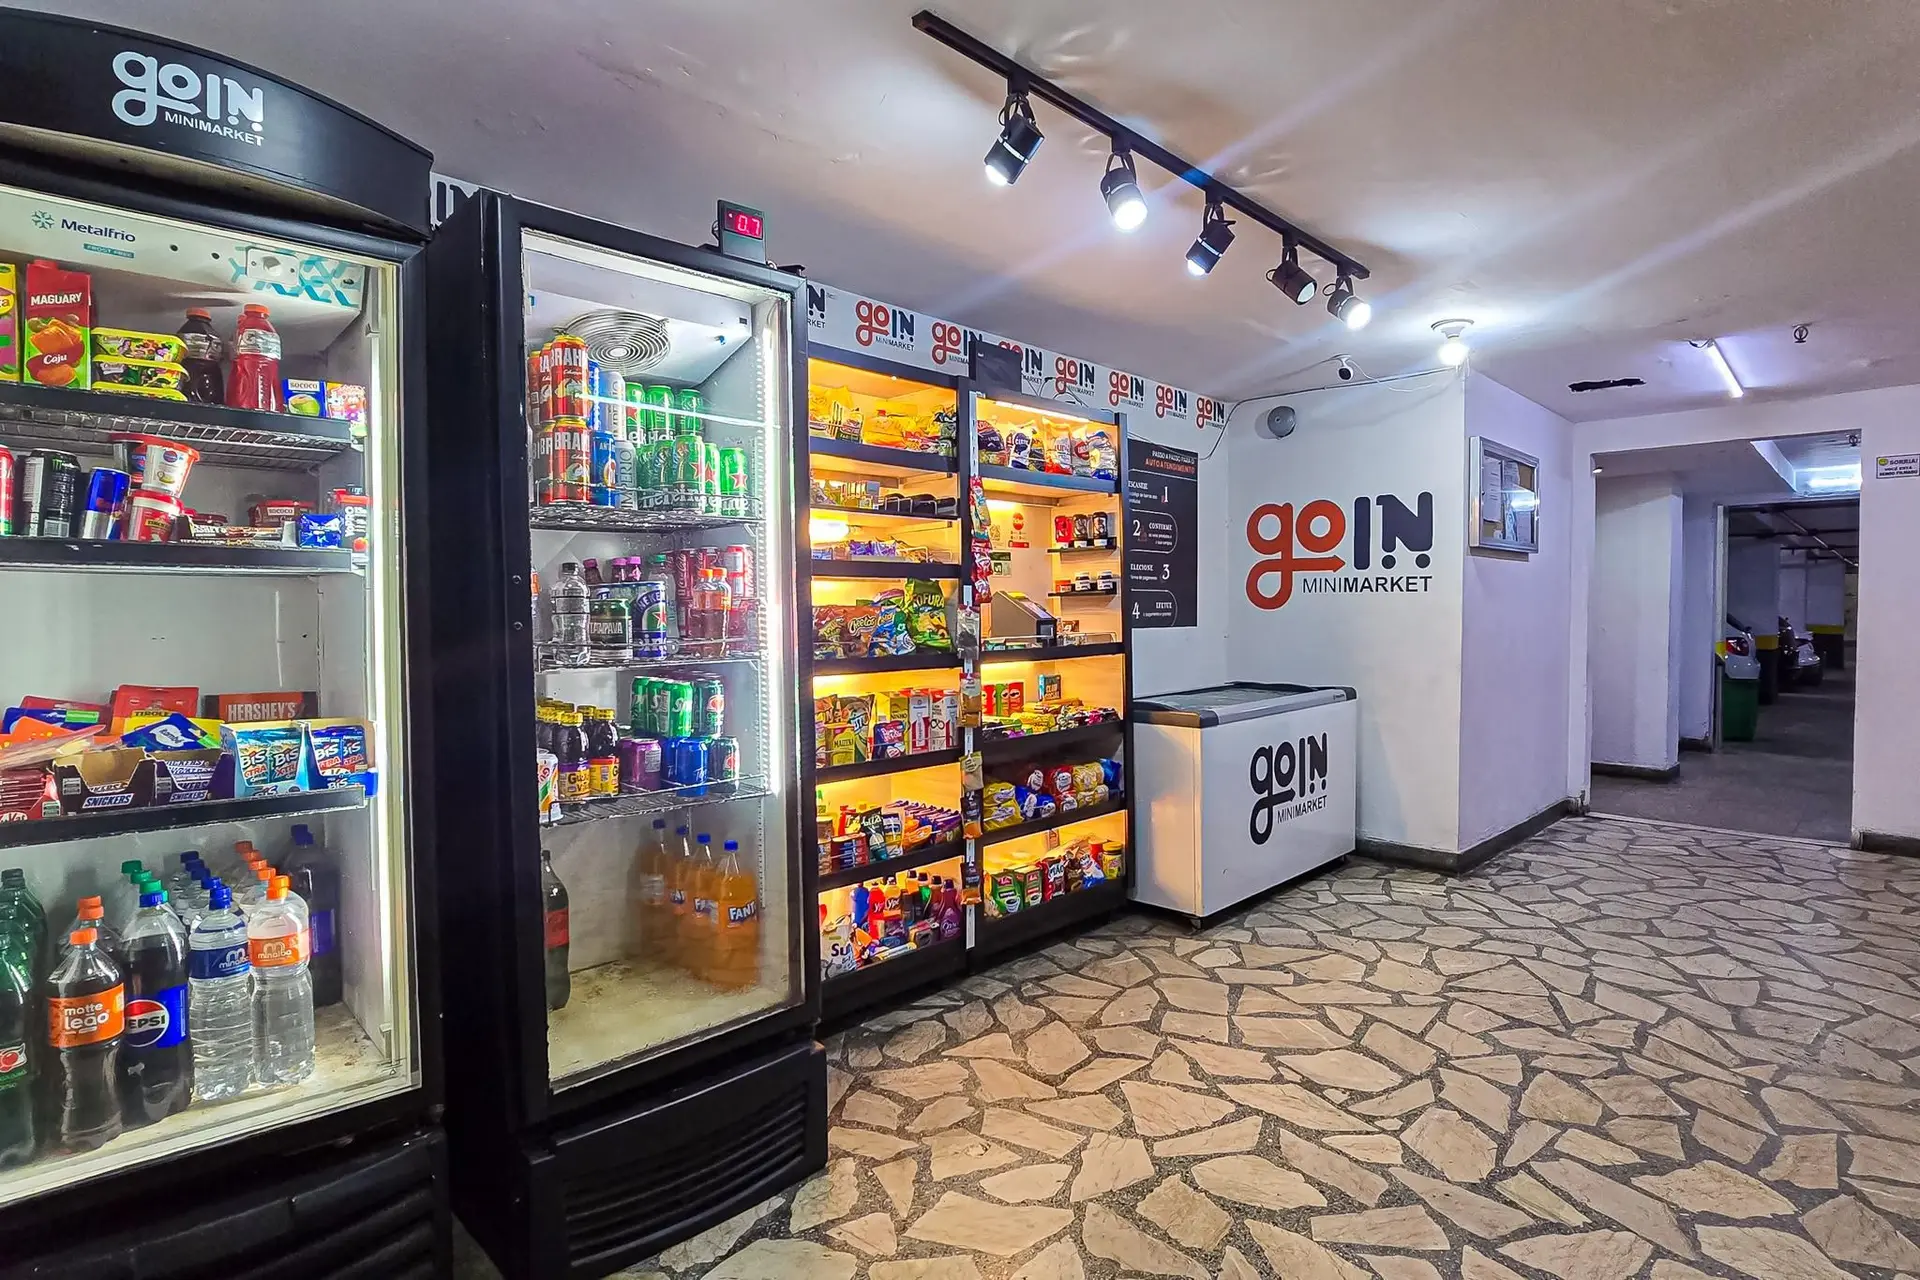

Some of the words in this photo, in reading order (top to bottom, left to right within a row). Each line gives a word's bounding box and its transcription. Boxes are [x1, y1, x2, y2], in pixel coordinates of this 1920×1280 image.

[164, 111, 265, 147] MINIMARKET
[61, 218, 136, 242] Metalfrio
[31, 292, 82, 306] MAGUARY
[290, 382, 318, 390] SOCOCO
[1164, 486, 1169, 503] 1
[1132, 519, 1141, 537] 2
[1162, 563, 1170, 580] 3
[1302, 575, 1433, 594] MINIMARKET
[1132, 601, 1140, 620] 4
[848, 615, 877, 634] Cheetos
[227, 701, 297, 720] HERSHEY'S
[275, 748, 299, 766] BiS
[85, 794, 132, 807] SNICKERS
[170, 791, 206, 801] SNICKERS
[1277, 794, 1327, 824] MINIMARKET
[729, 901, 757, 921] FANT
[219, 955, 249, 969] minalb
[257, 949, 292, 960] minalba
[64, 1002, 104, 1017] matte
[129, 1014, 167, 1030] EPSI
